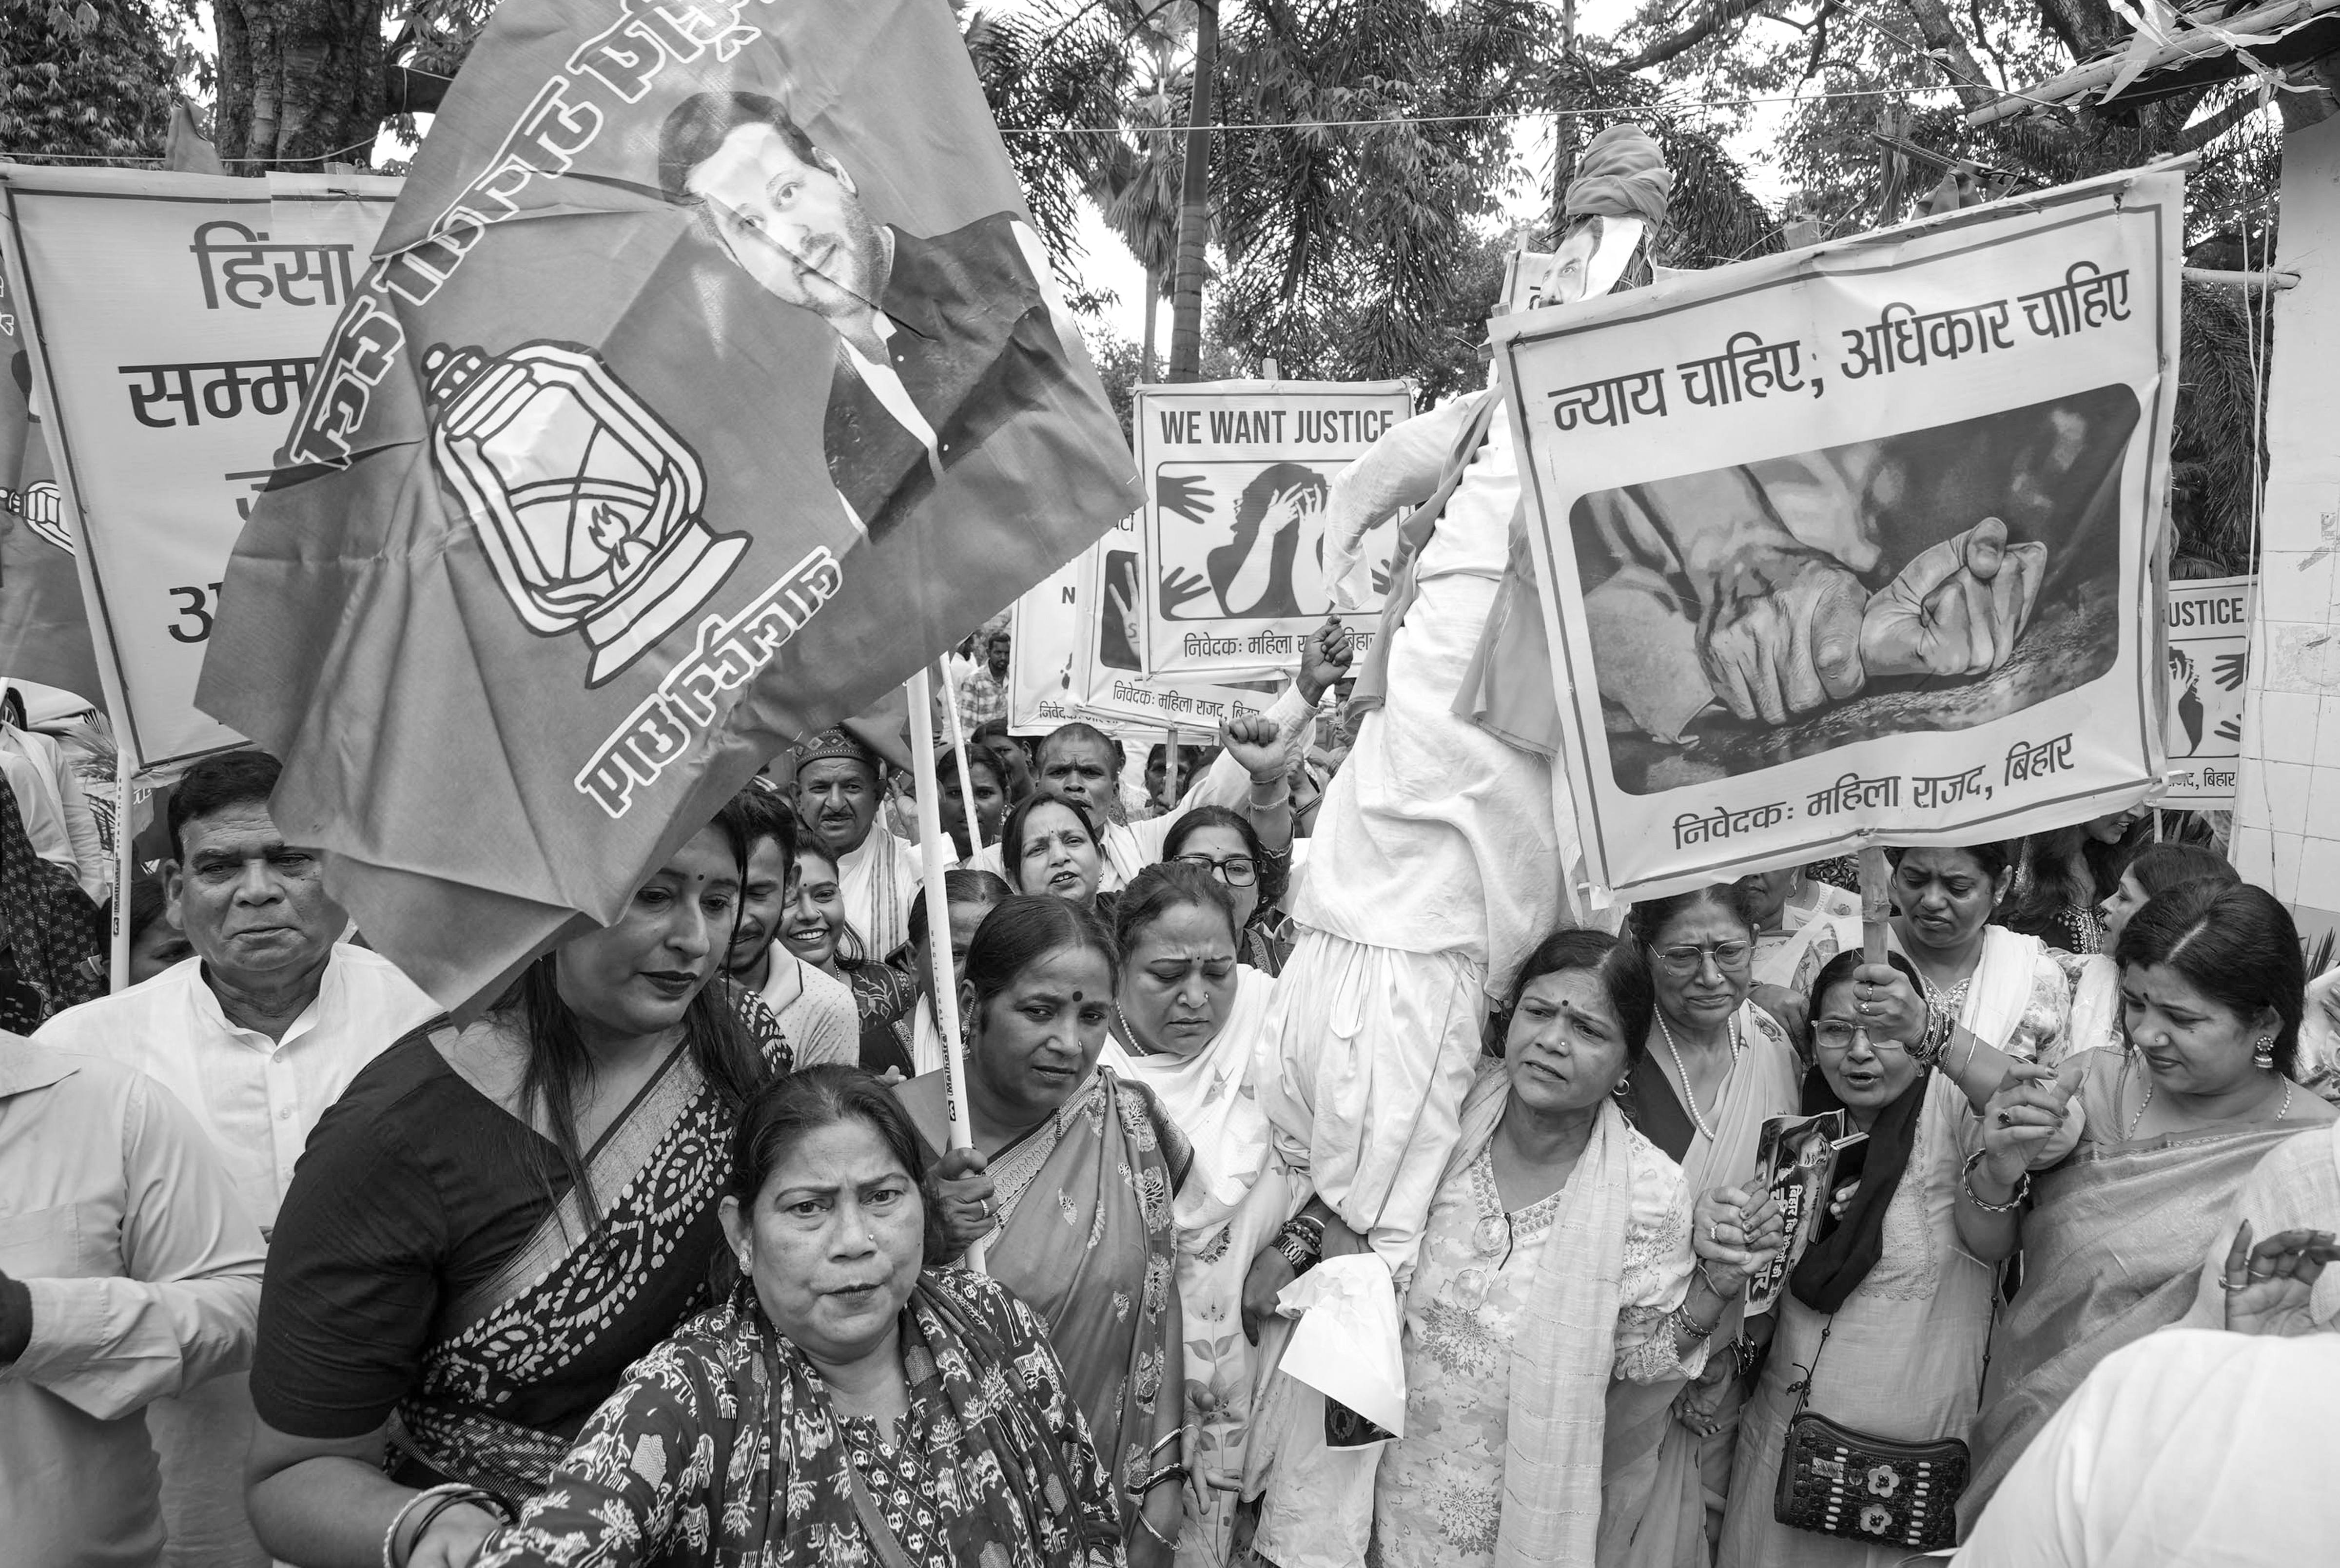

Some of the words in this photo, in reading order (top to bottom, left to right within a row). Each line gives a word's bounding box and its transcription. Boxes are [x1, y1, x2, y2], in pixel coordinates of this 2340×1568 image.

[189, 220, 354, 309] हिंसा
[1548, 368, 1667, 431] न्याय
[1841, 301, 2014, 379] अधिकार
[2017, 261, 2131, 338] चाहिए
[118, 357, 320, 428] सम्म
[1161, 411, 1202, 444] WE
[1210, 410, 1287, 444] WANT
[2169, 598, 2244, 627] USTICE
[1248, 630, 1292, 655] महिला
[1158, 690, 1192, 714] महिला
[1807, 773, 1901, 816] महिला
[1912, 765, 1992, 808] राजद,
[2005, 733, 2074, 786] बिहार
[2204, 767, 2236, 787] बिहार
[941, 1034, 953, 1096] Malhotra
